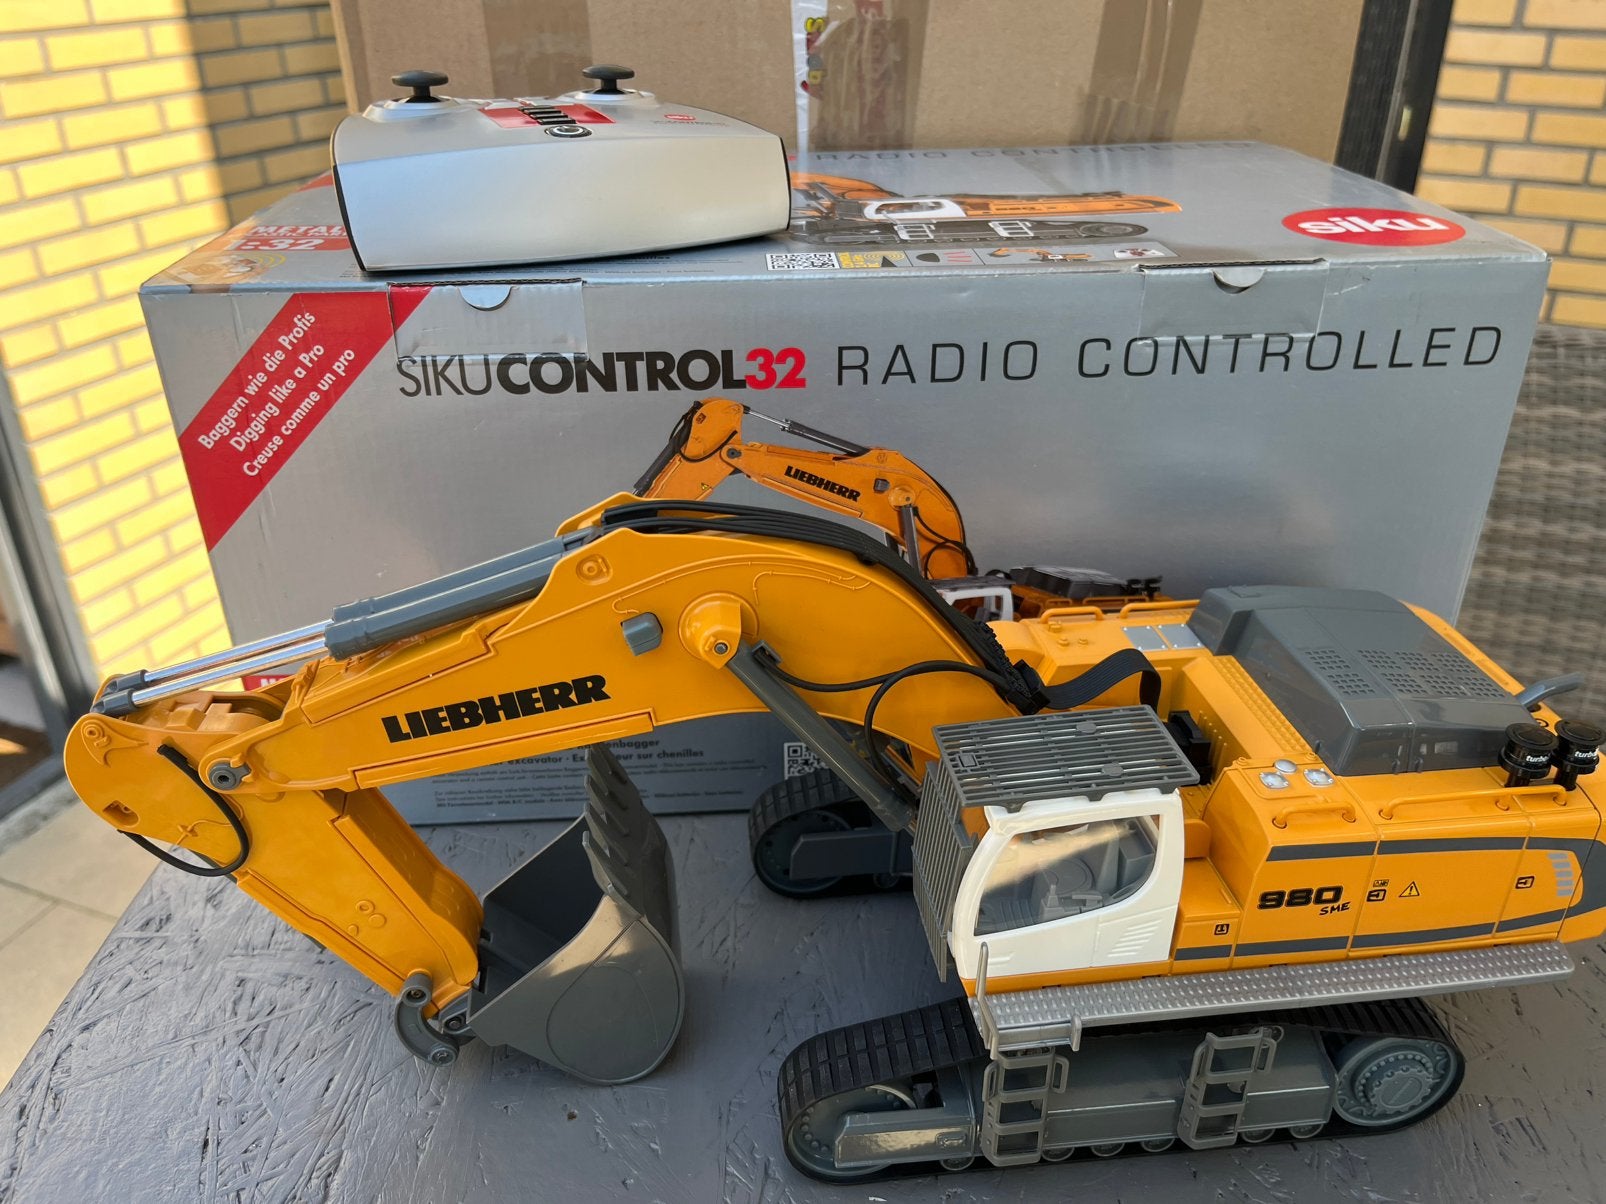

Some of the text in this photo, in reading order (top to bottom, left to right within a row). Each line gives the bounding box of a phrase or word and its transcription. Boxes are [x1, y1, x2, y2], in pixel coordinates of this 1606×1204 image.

[1297, 217, 1450, 235] siku
[198, 313, 315, 449] Baggern wie die Profis
[837, 339, 1039, 387] RADIO
[1077, 326, 1502, 379] CONTROLLED
[230, 344, 325, 451] Digging like a Pro
[243, 350, 355, 476] Creuse comme un pro
[784, 465, 861, 502] LIEBHERR
[381, 674, 612, 743] LIEBHERR
[637, 752, 653, 761] sur
[656, 748, 704, 760] chenilles
[1257, 885, 1344, 910] 980
[1319, 901, 1351, 916] SME
